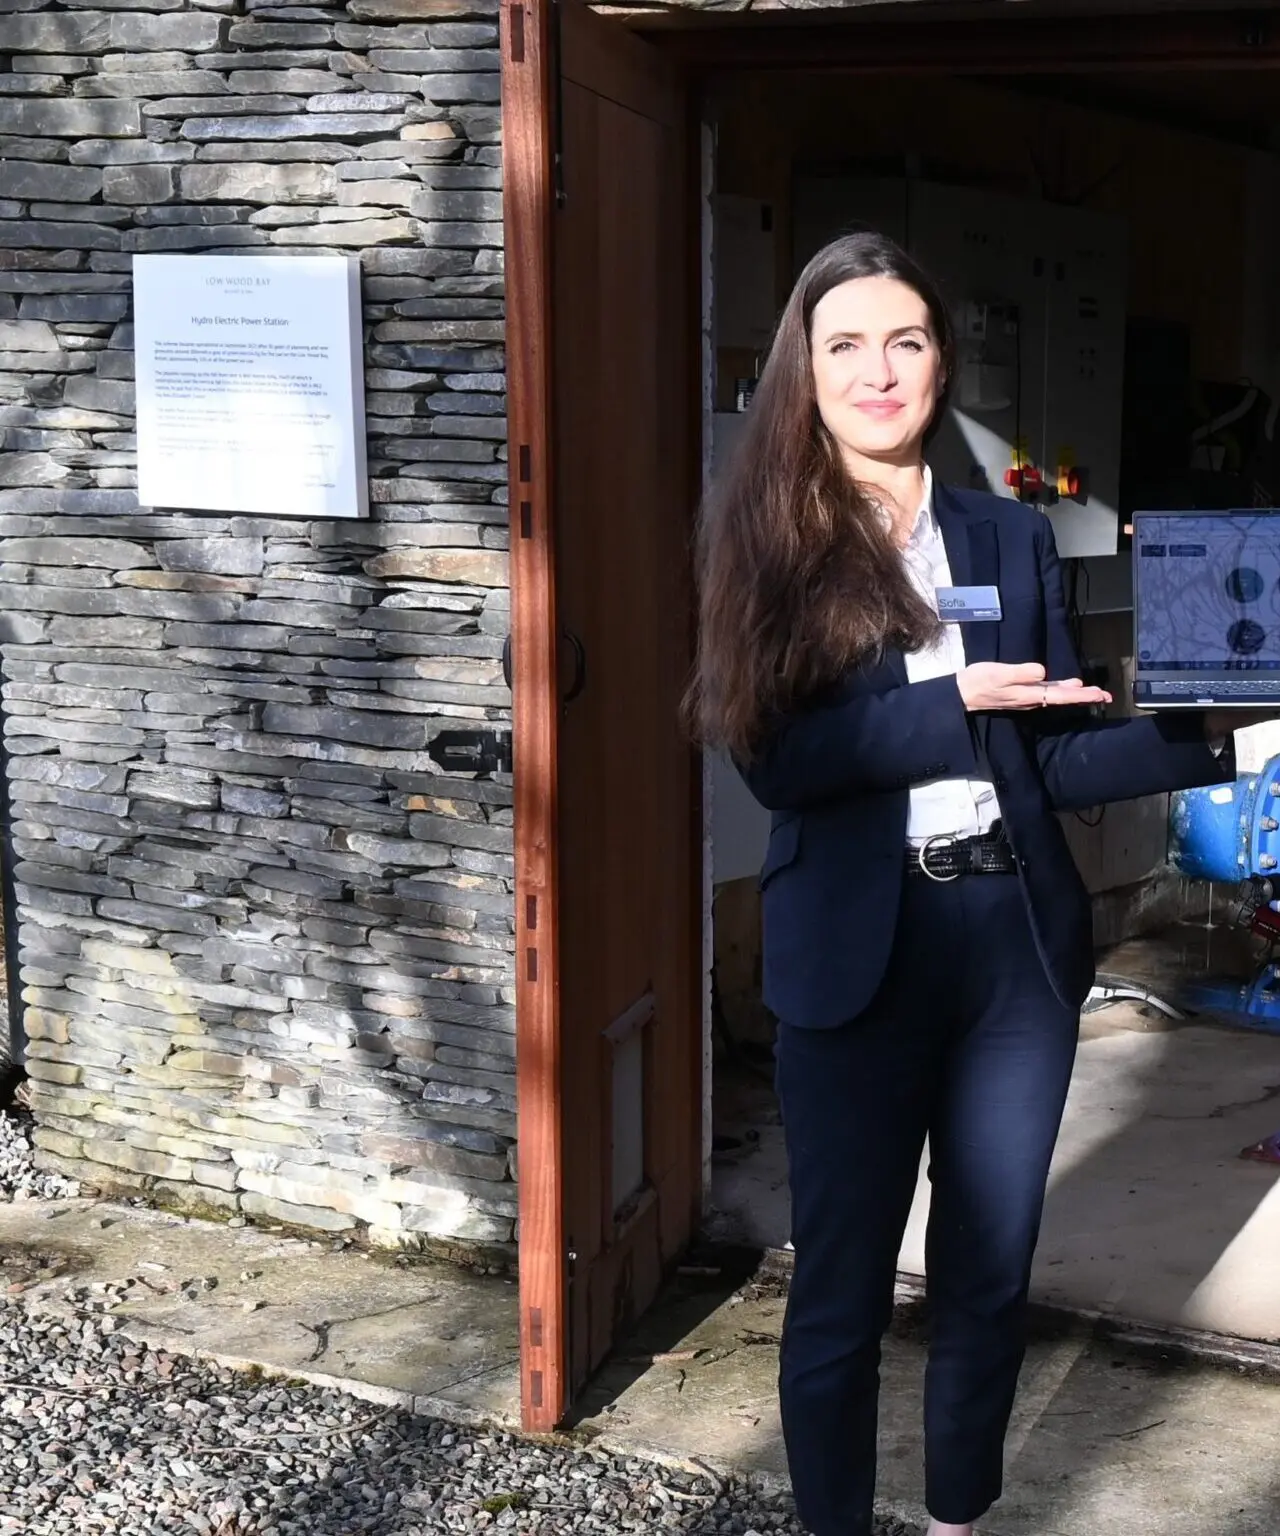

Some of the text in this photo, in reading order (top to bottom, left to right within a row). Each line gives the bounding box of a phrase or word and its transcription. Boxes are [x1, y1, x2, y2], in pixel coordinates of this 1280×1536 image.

[226, 277, 253, 286] WOOD
[255, 277, 271, 286] BAY
[191, 316, 289, 326] Hydro Electric Power Station
[939, 598, 966, 608] Sofia
